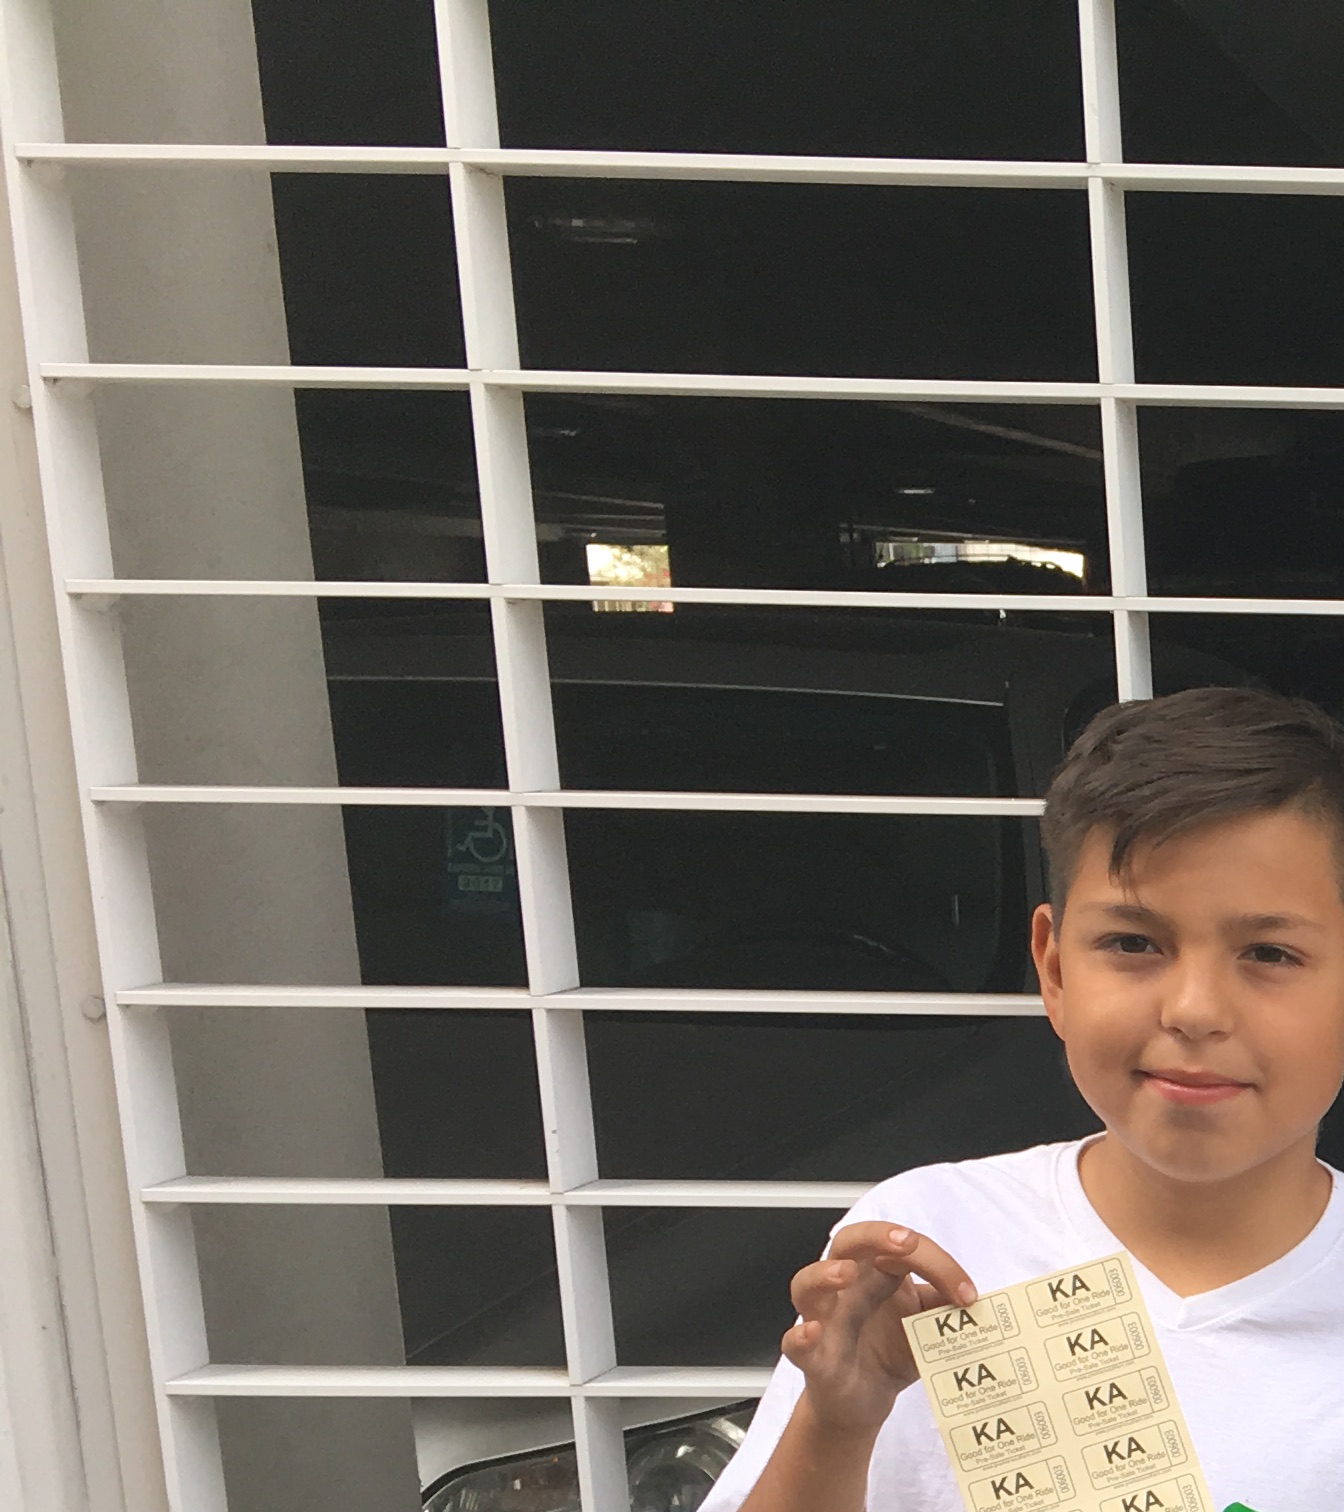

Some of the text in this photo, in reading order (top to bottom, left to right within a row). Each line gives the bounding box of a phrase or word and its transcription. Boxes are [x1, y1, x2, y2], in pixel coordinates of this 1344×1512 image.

[1047, 1275, 1091, 1302] KA
[1036, 1289, 1111, 1318] Good for One Ride
[934, 1309, 979, 1337] KA
[922, 1324, 999, 1353] Good for One Ride
[1066, 1329, 1110, 1356] KA
[1054, 1343, 1129, 1372] Good for One Ride
[953, 1364, 997, 1391] KA
[941, 1378, 1017, 1407] Good for One Ride
[1084, 1383, 1128, 1410] KA
[1072, 1397, 1148, 1426] Good for One Ride
[971, 1418, 1016, 1445] KA
[960, 1432, 1036, 1462] Good for One Ride
[1103, 1437, 1147, 1464] KA
[1091, 1451, 1166, 1480] Good for One Ride
[990, 1472, 1035, 1500] KA
[1002, 1499, 1014, 1508] for
[1015, 1493, 1034, 1504] One
[1034, 1486, 1055, 1498] Ride
